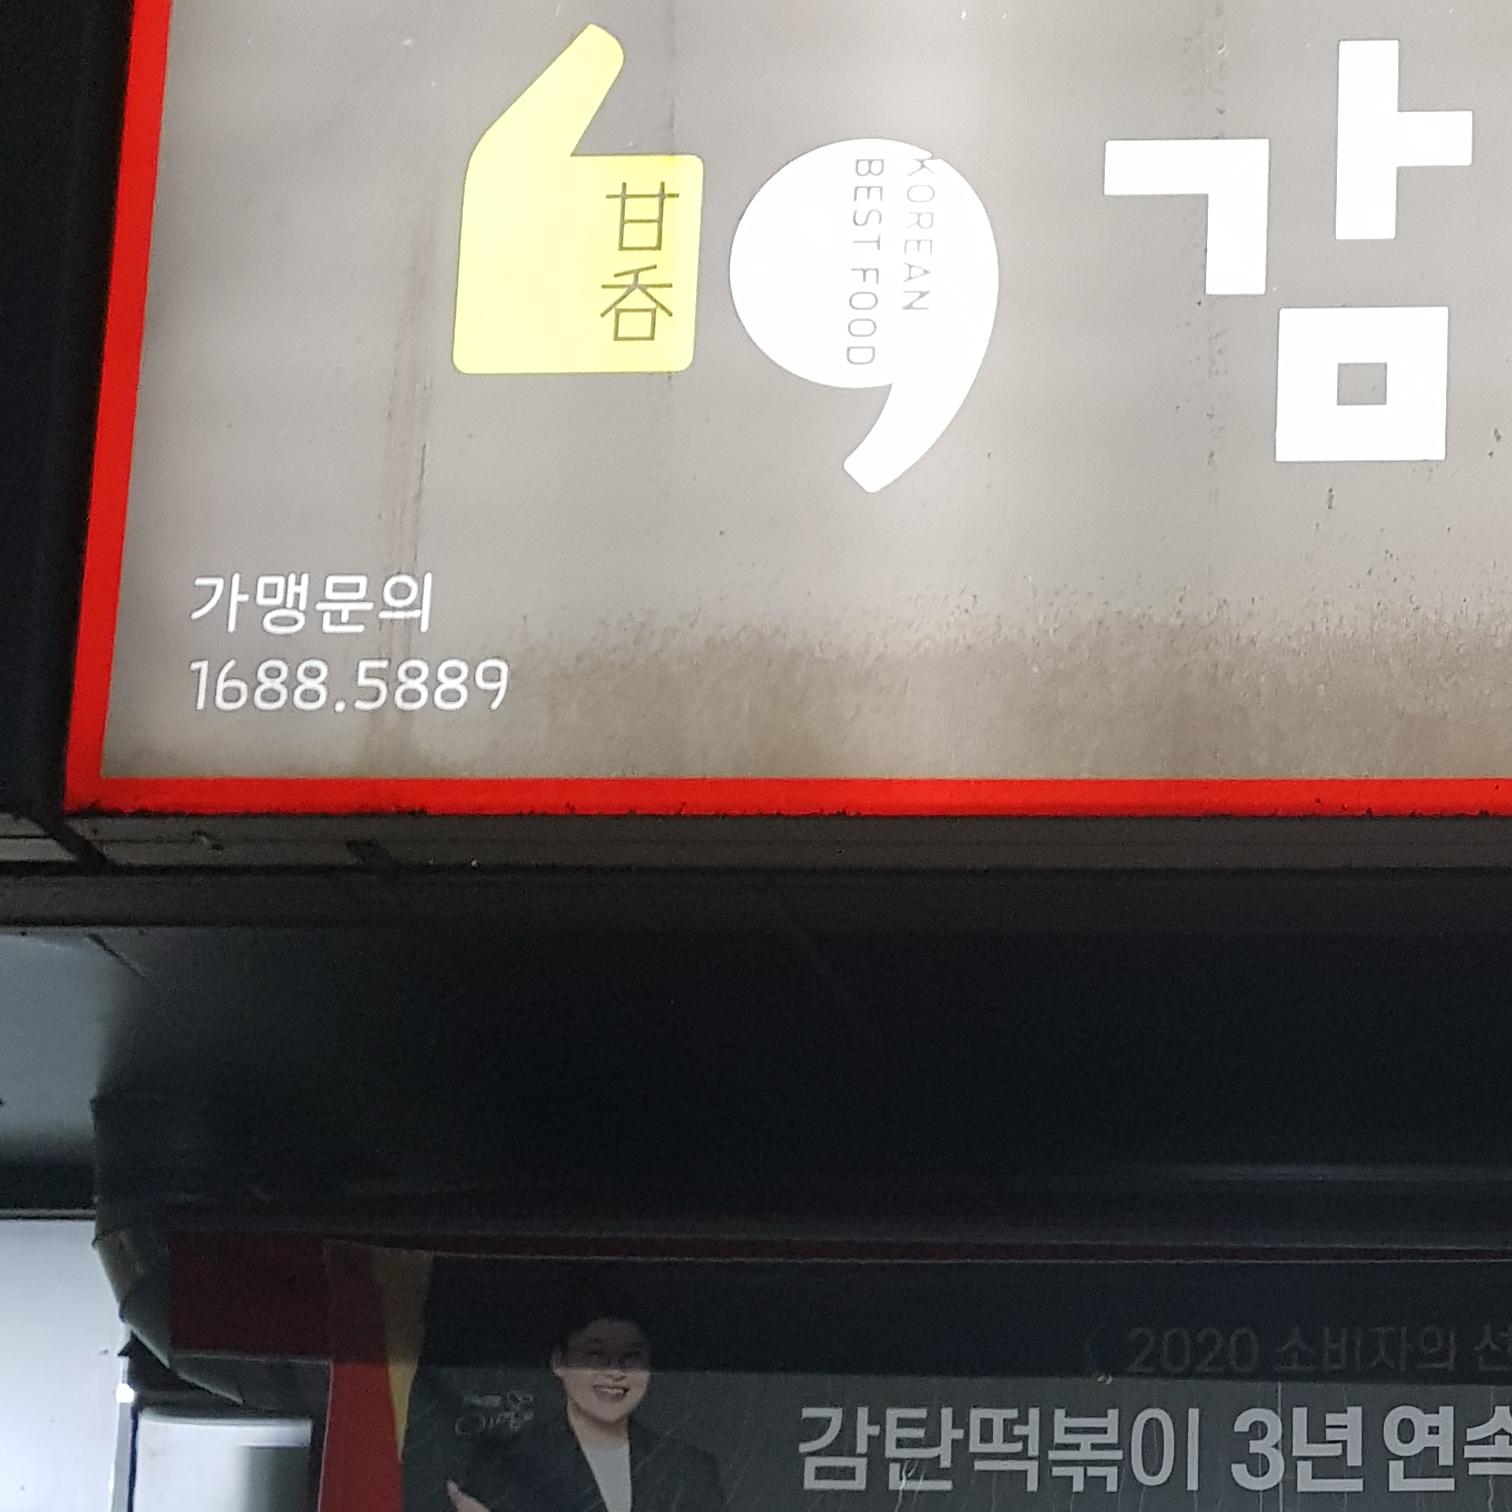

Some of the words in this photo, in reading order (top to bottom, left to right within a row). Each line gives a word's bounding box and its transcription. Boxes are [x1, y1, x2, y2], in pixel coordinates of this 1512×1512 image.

[852, 158, 885, 252] BEST
[902, 157, 936, 311] KOREAN
[846, 267, 880, 366] FOOD
[190, 572, 433, 635] 가맹문의
[189, 657, 511, 713] 1688.5889
[1127, 1325, 1260, 1376] 2020
[1272, 1324, 1458, 1374] 소비자의
[797, 1405, 1202, 1494] 감탄떡볶이
